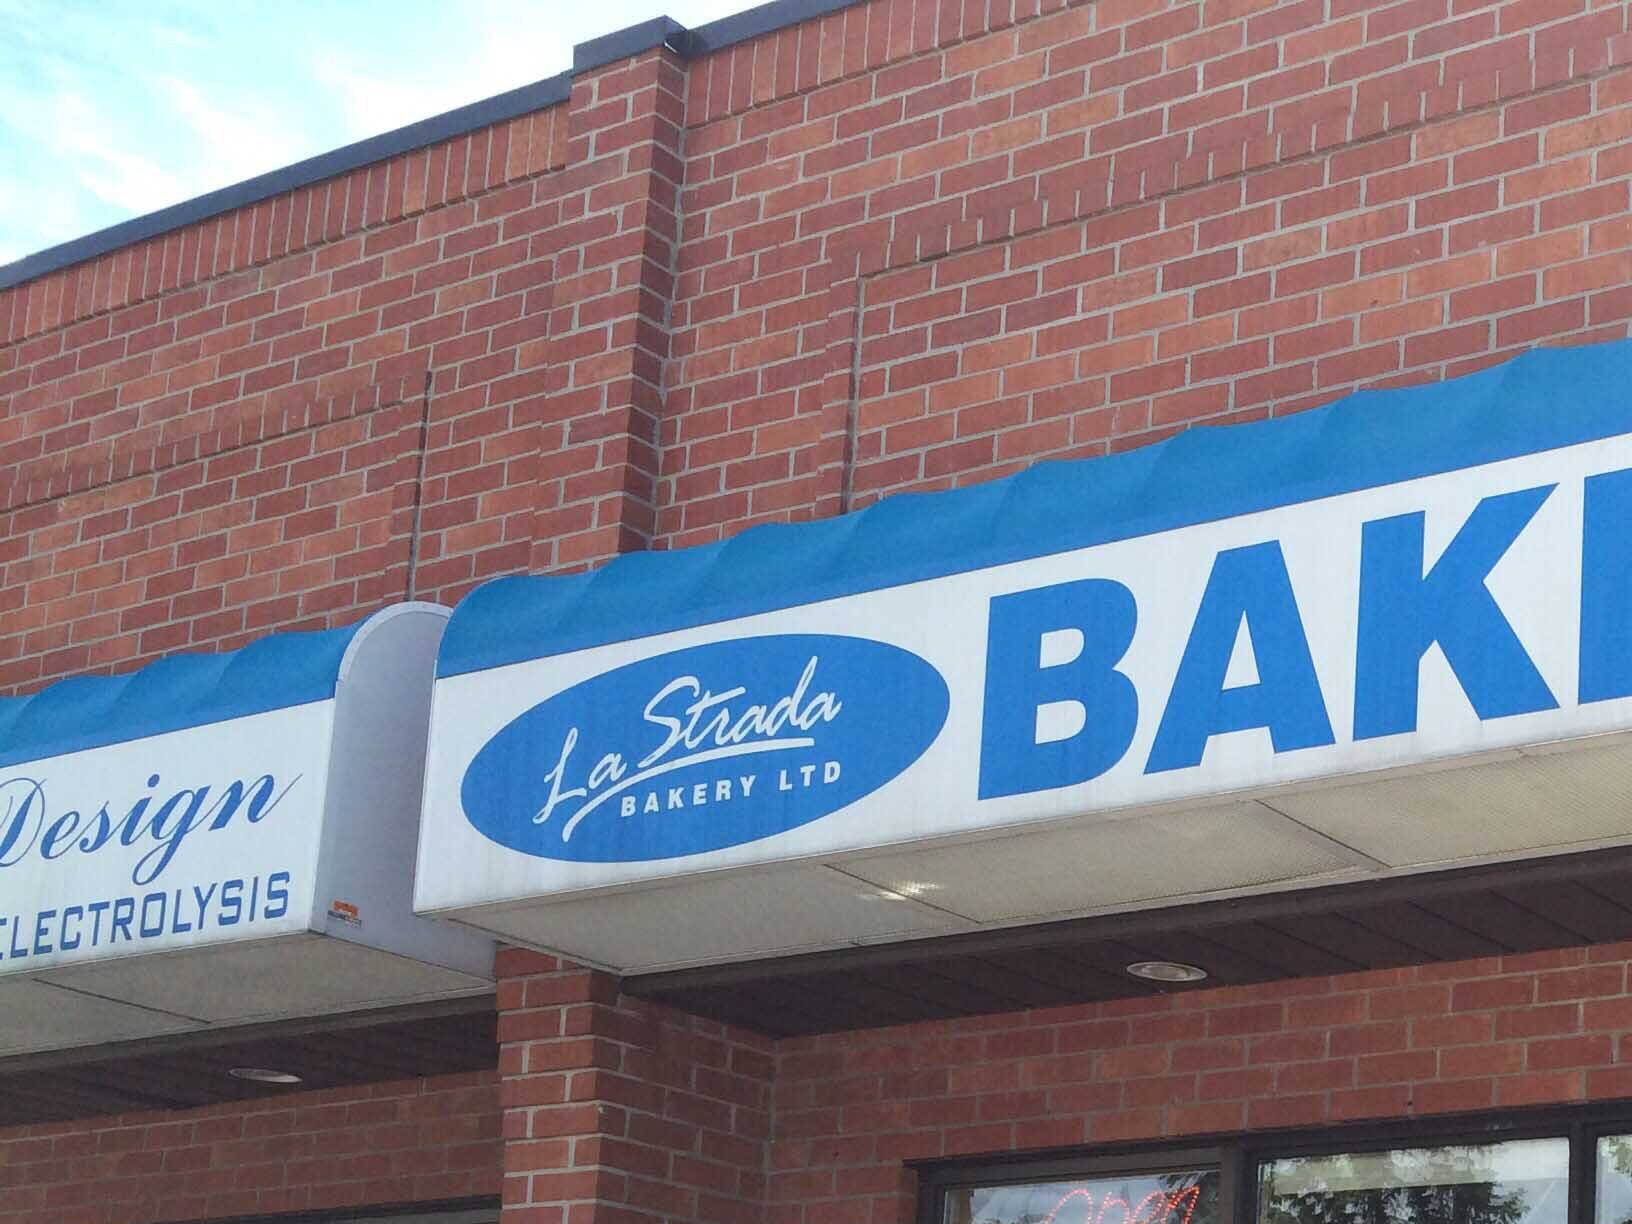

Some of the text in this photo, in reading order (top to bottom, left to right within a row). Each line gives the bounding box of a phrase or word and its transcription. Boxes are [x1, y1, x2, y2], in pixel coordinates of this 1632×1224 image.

[533, 655, 843, 824] La Strada
[620, 761, 842, 818] BAKERY LTD
[0, 773, 303, 886] Design
